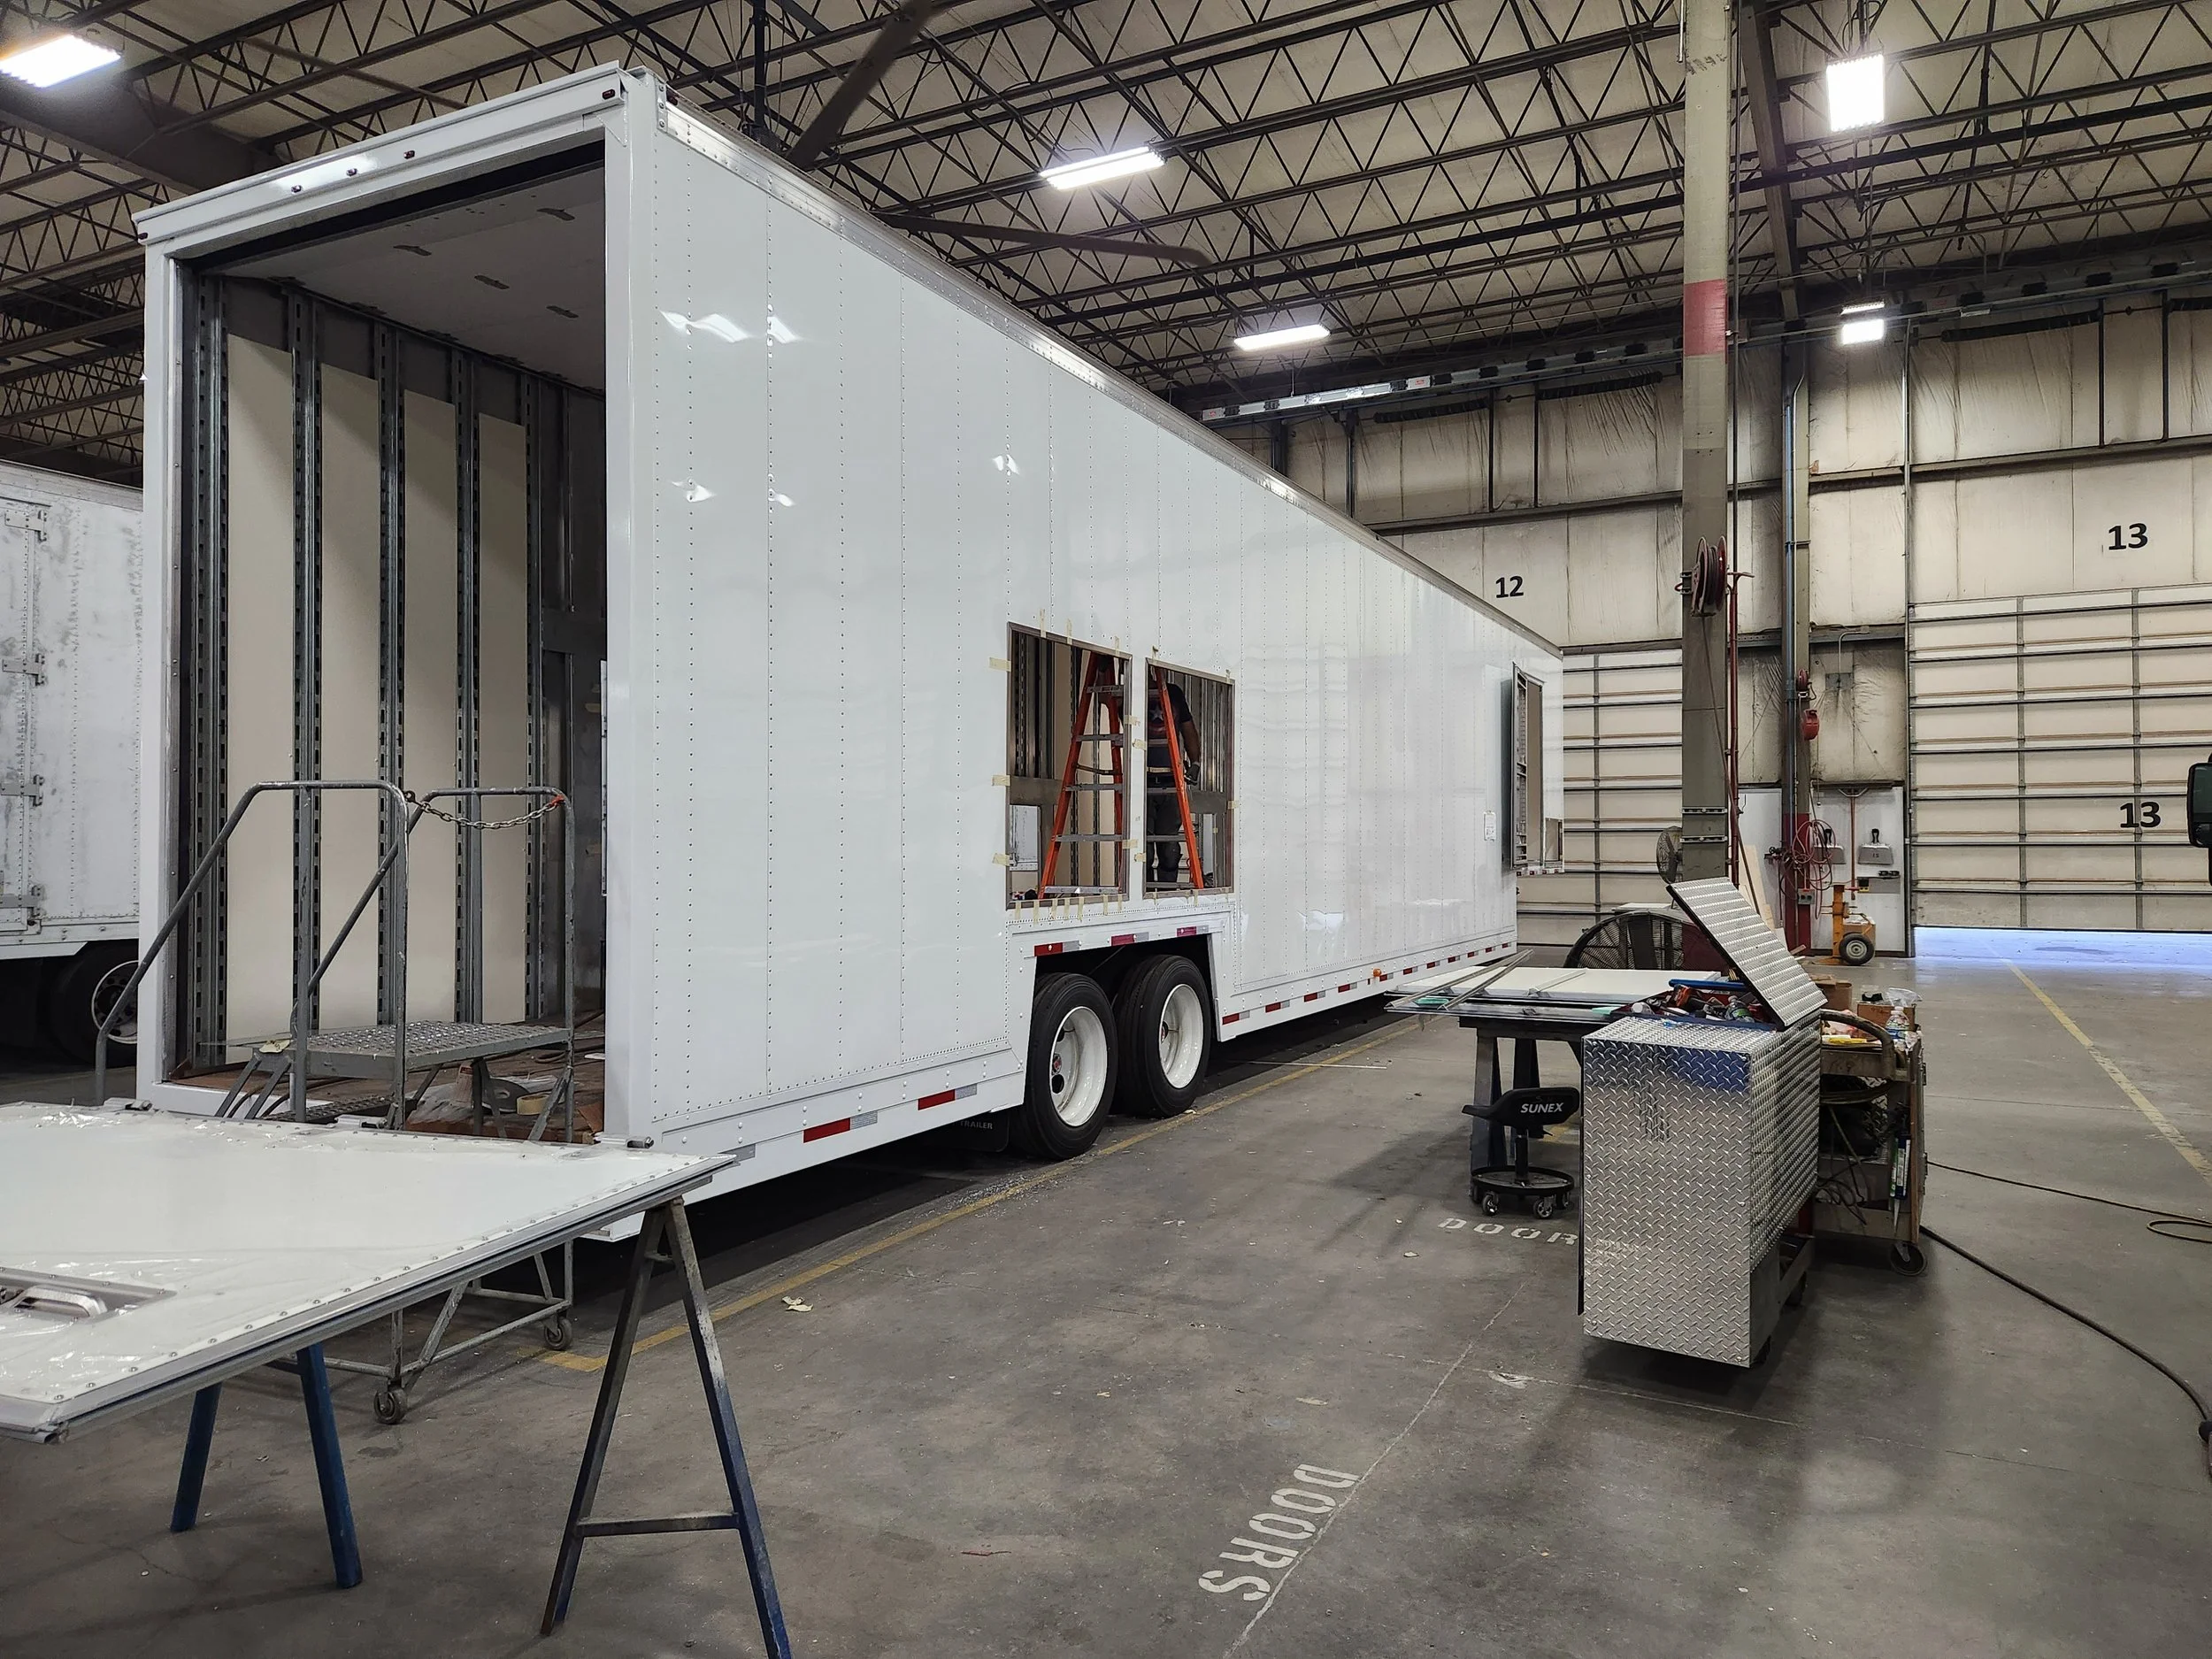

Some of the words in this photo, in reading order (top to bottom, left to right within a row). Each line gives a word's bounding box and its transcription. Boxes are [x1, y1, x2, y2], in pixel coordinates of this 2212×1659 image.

[2108, 523, 2148, 550] 13
[1495, 576, 1524, 598] 12
[2120, 802, 2161, 827] 13
[1520, 1102, 1564, 1113] SUNEX
[960, 1120, 993, 1130] TRAILER
[1198, 1463, 1360, 1601] DOORS
